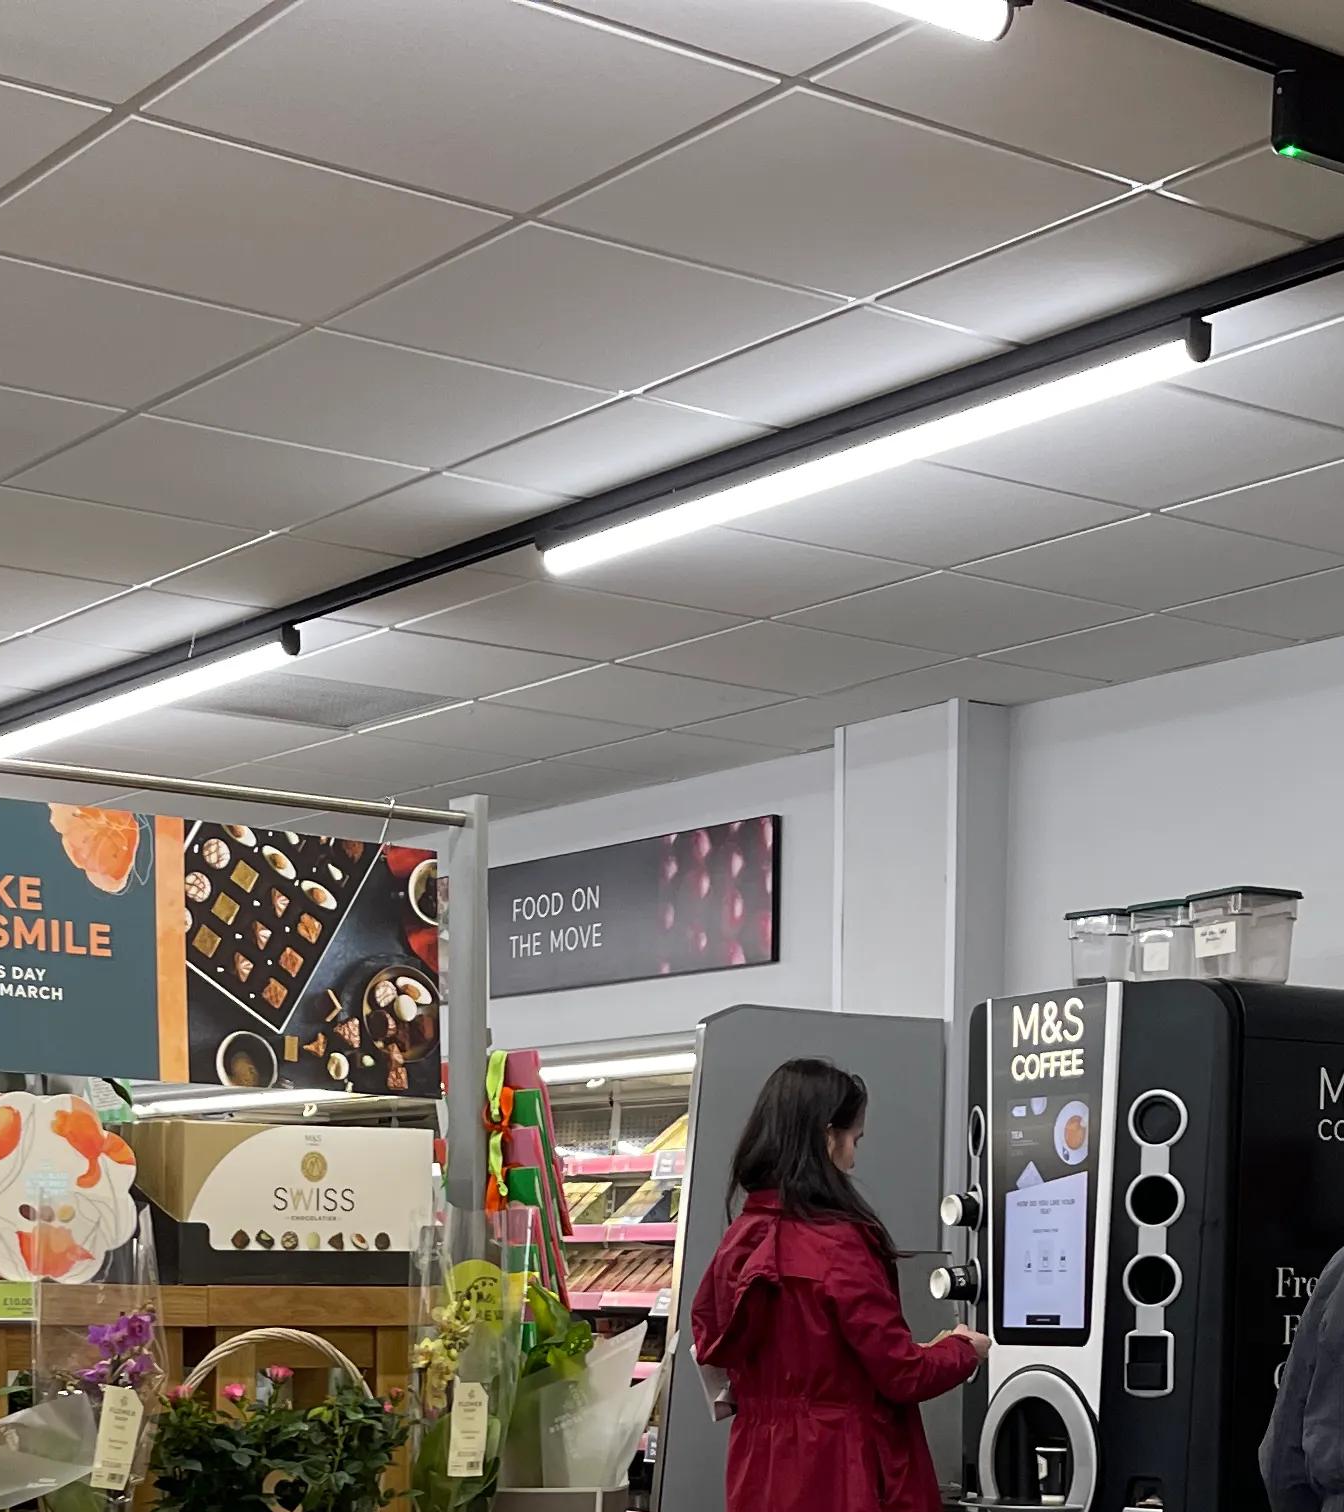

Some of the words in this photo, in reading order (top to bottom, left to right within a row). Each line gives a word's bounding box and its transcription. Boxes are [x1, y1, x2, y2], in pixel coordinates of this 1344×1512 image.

[512, 892, 564, 923] FOOD
[572, 885, 600, 912] ON
[510, 932, 542, 959] THE
[550, 923, 603, 954] MOVE
[11, 966, 46, 982] DAY
[0, 983, 63, 1001] MARCH
[1012, 997, 1084, 1048] M&S
[1011, 1048, 1085, 1081] COFFEE
[273, 1186, 356, 1212] SWISS
